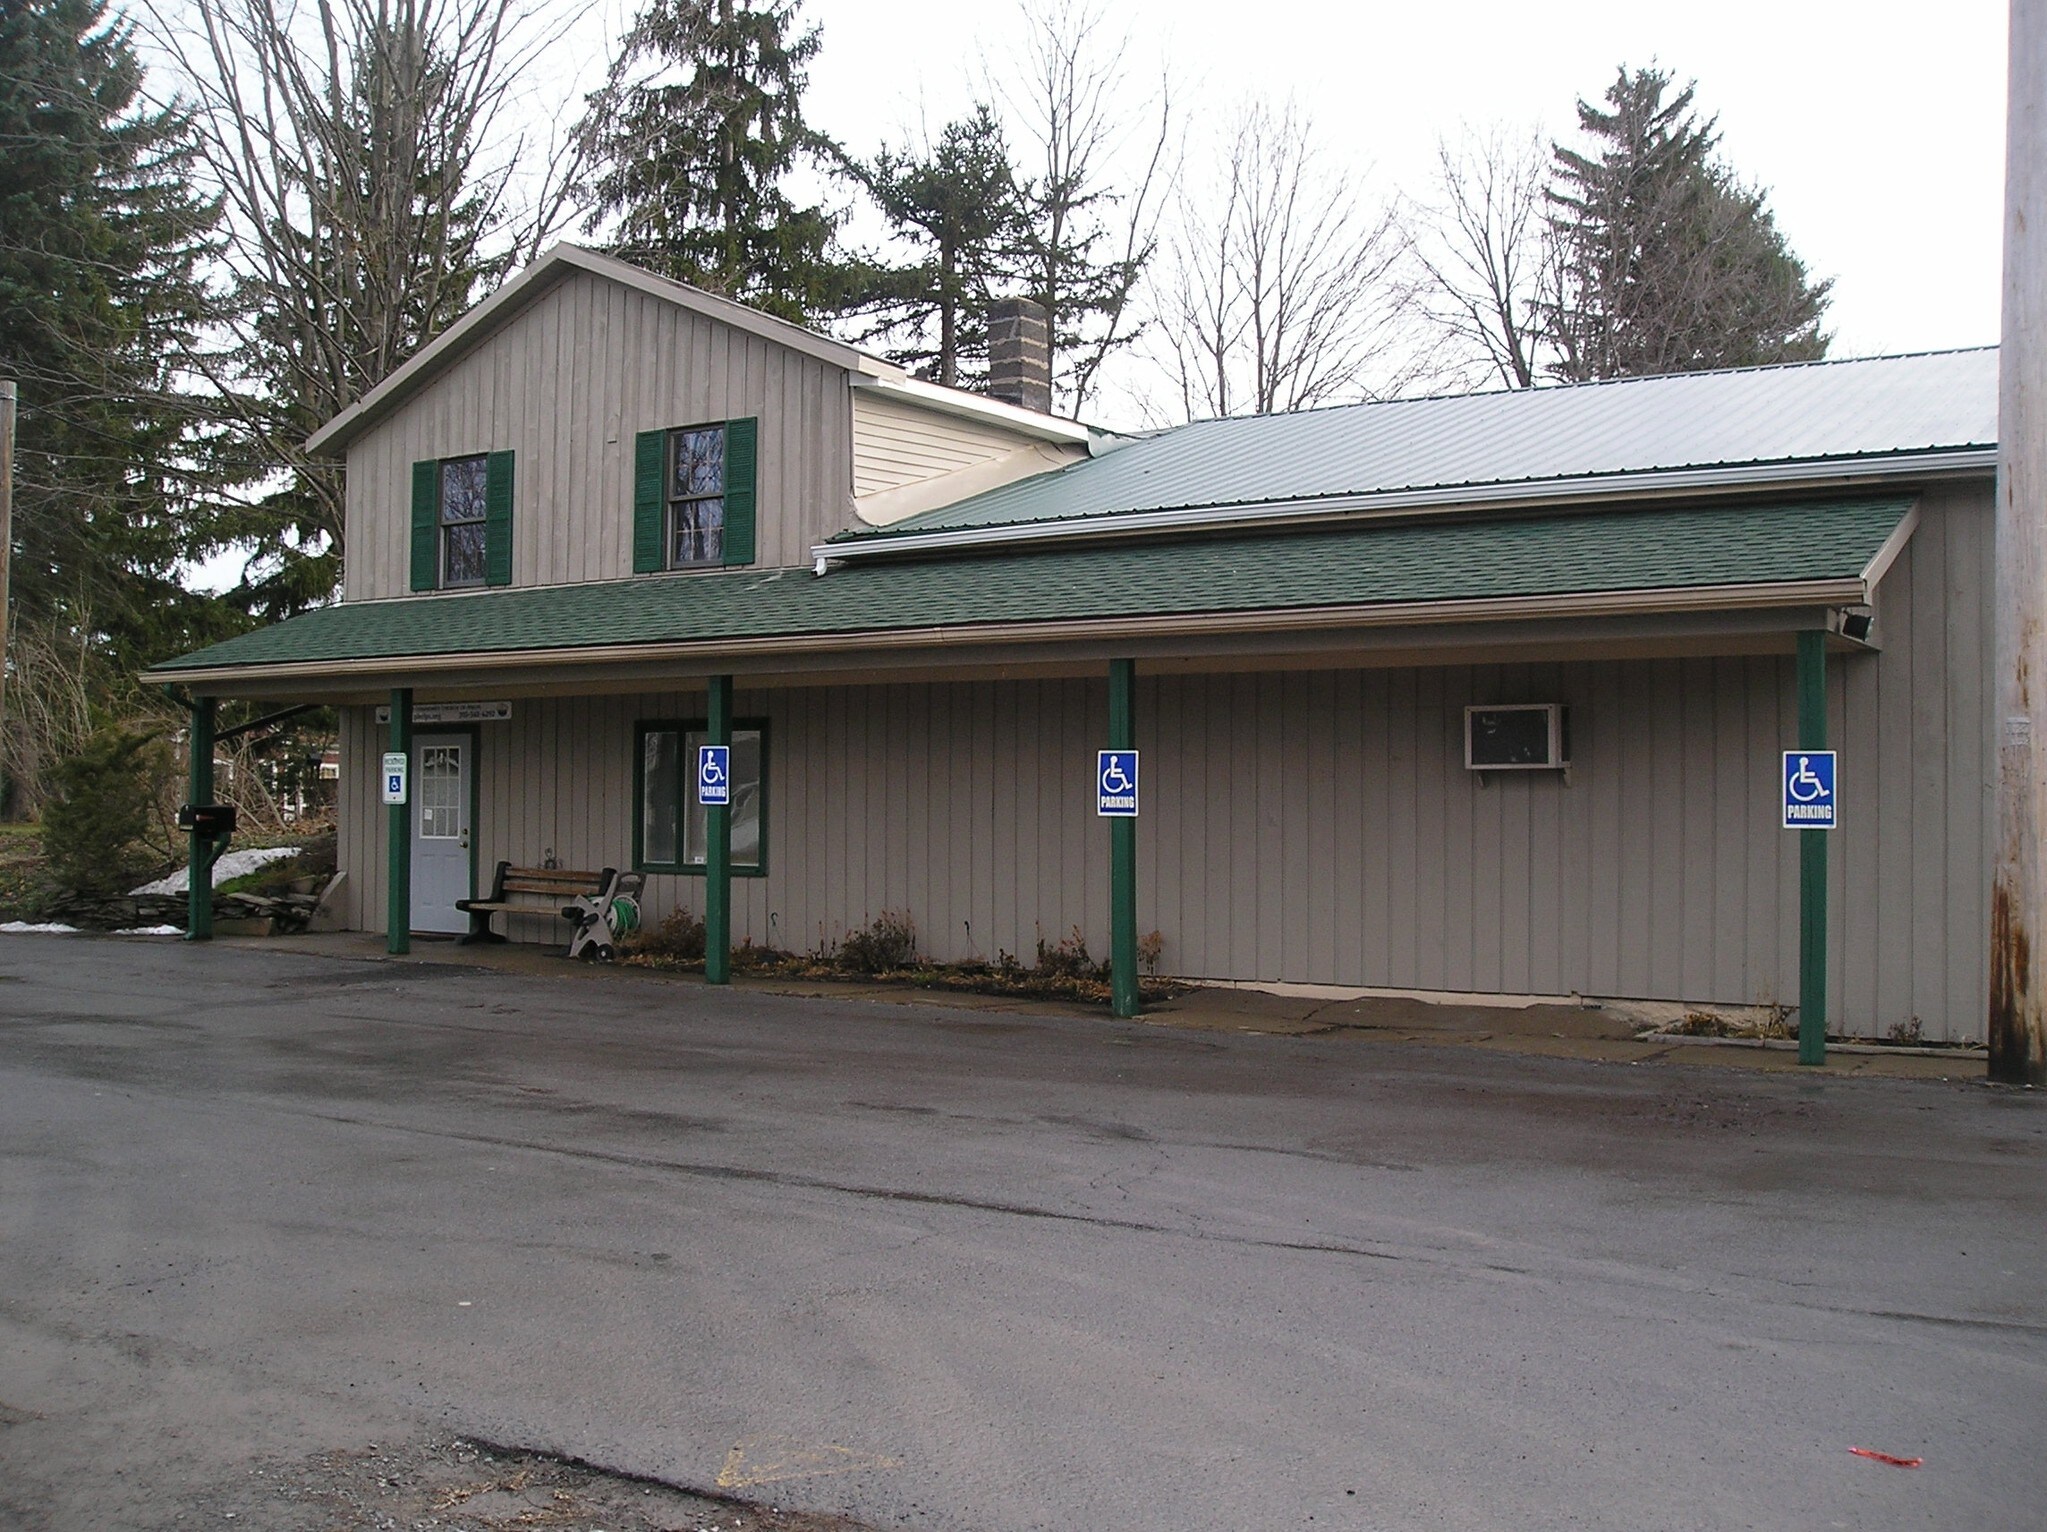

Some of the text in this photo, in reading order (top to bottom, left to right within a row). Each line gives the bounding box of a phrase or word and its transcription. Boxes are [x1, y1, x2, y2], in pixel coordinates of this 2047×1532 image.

[701, 785, 727, 798] PARKING
[1100, 795, 1135, 809] PARKING
[1787, 804, 1833, 820] PARKING
